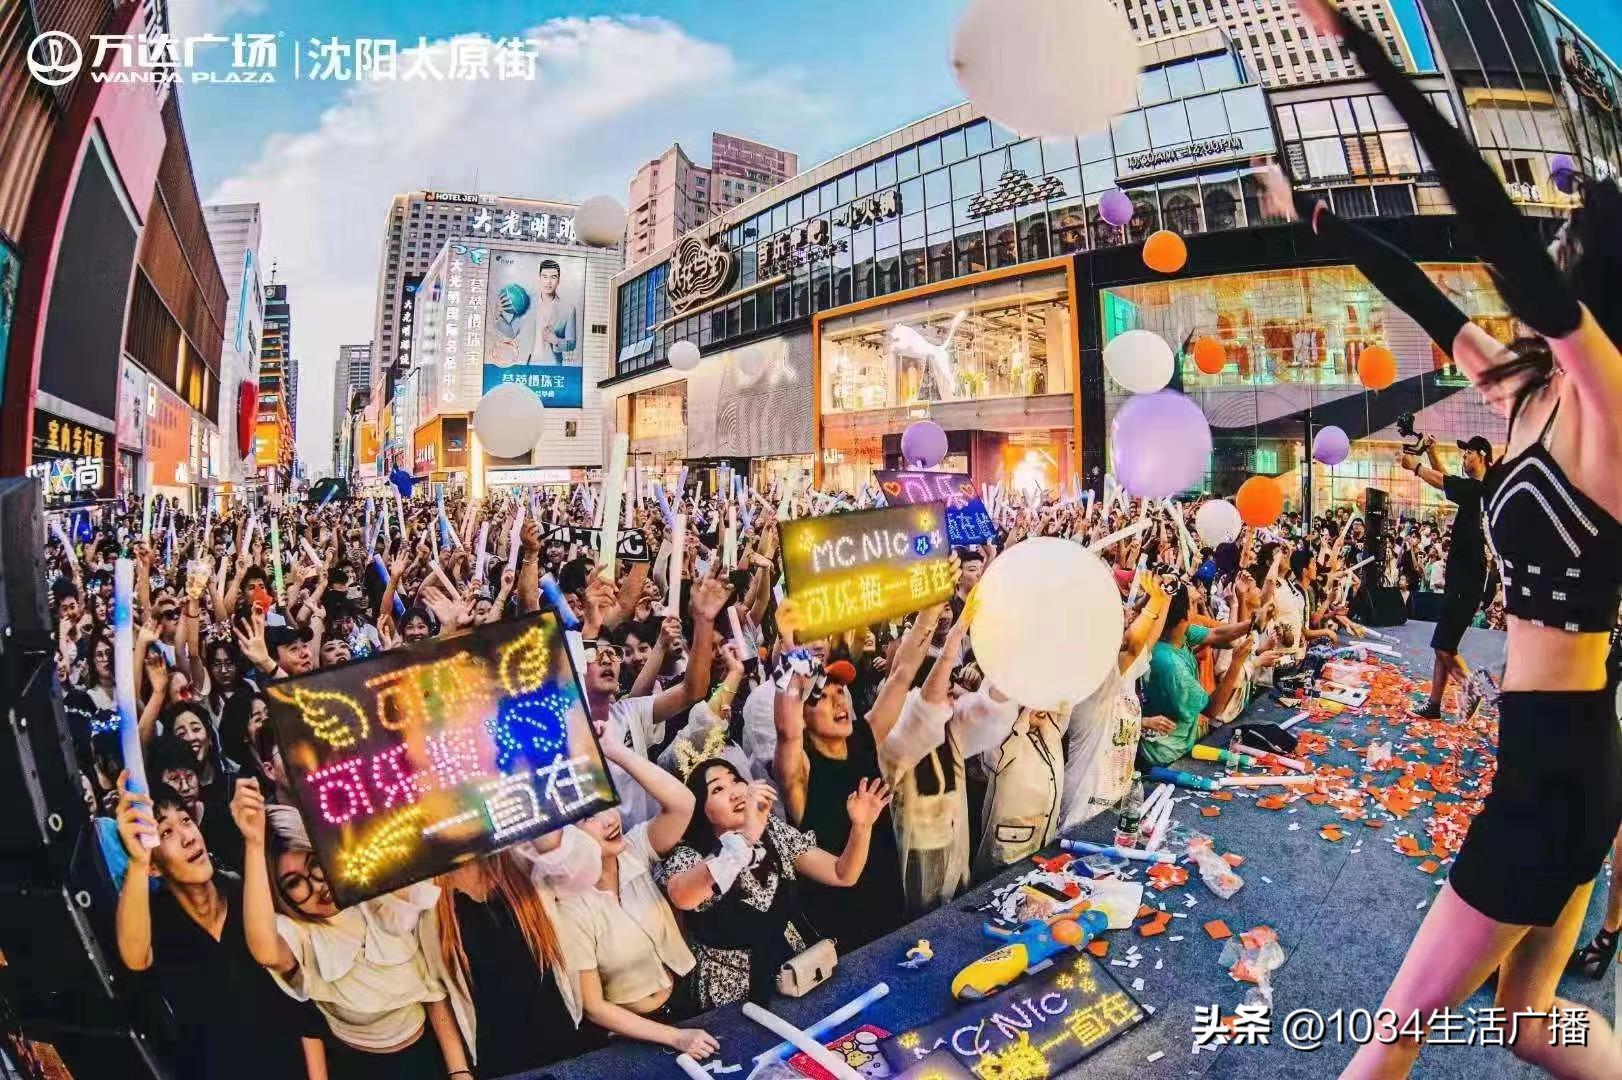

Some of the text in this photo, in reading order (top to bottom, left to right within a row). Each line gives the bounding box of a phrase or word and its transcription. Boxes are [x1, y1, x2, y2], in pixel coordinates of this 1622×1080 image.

[436, 193, 462, 202] HOTEL
[463, 195, 479, 203] JEN
[811, 530, 908, 572] MC NIC
[422, 752, 594, 841] 一直在
[995, 992, 1068, 1040] NIC
